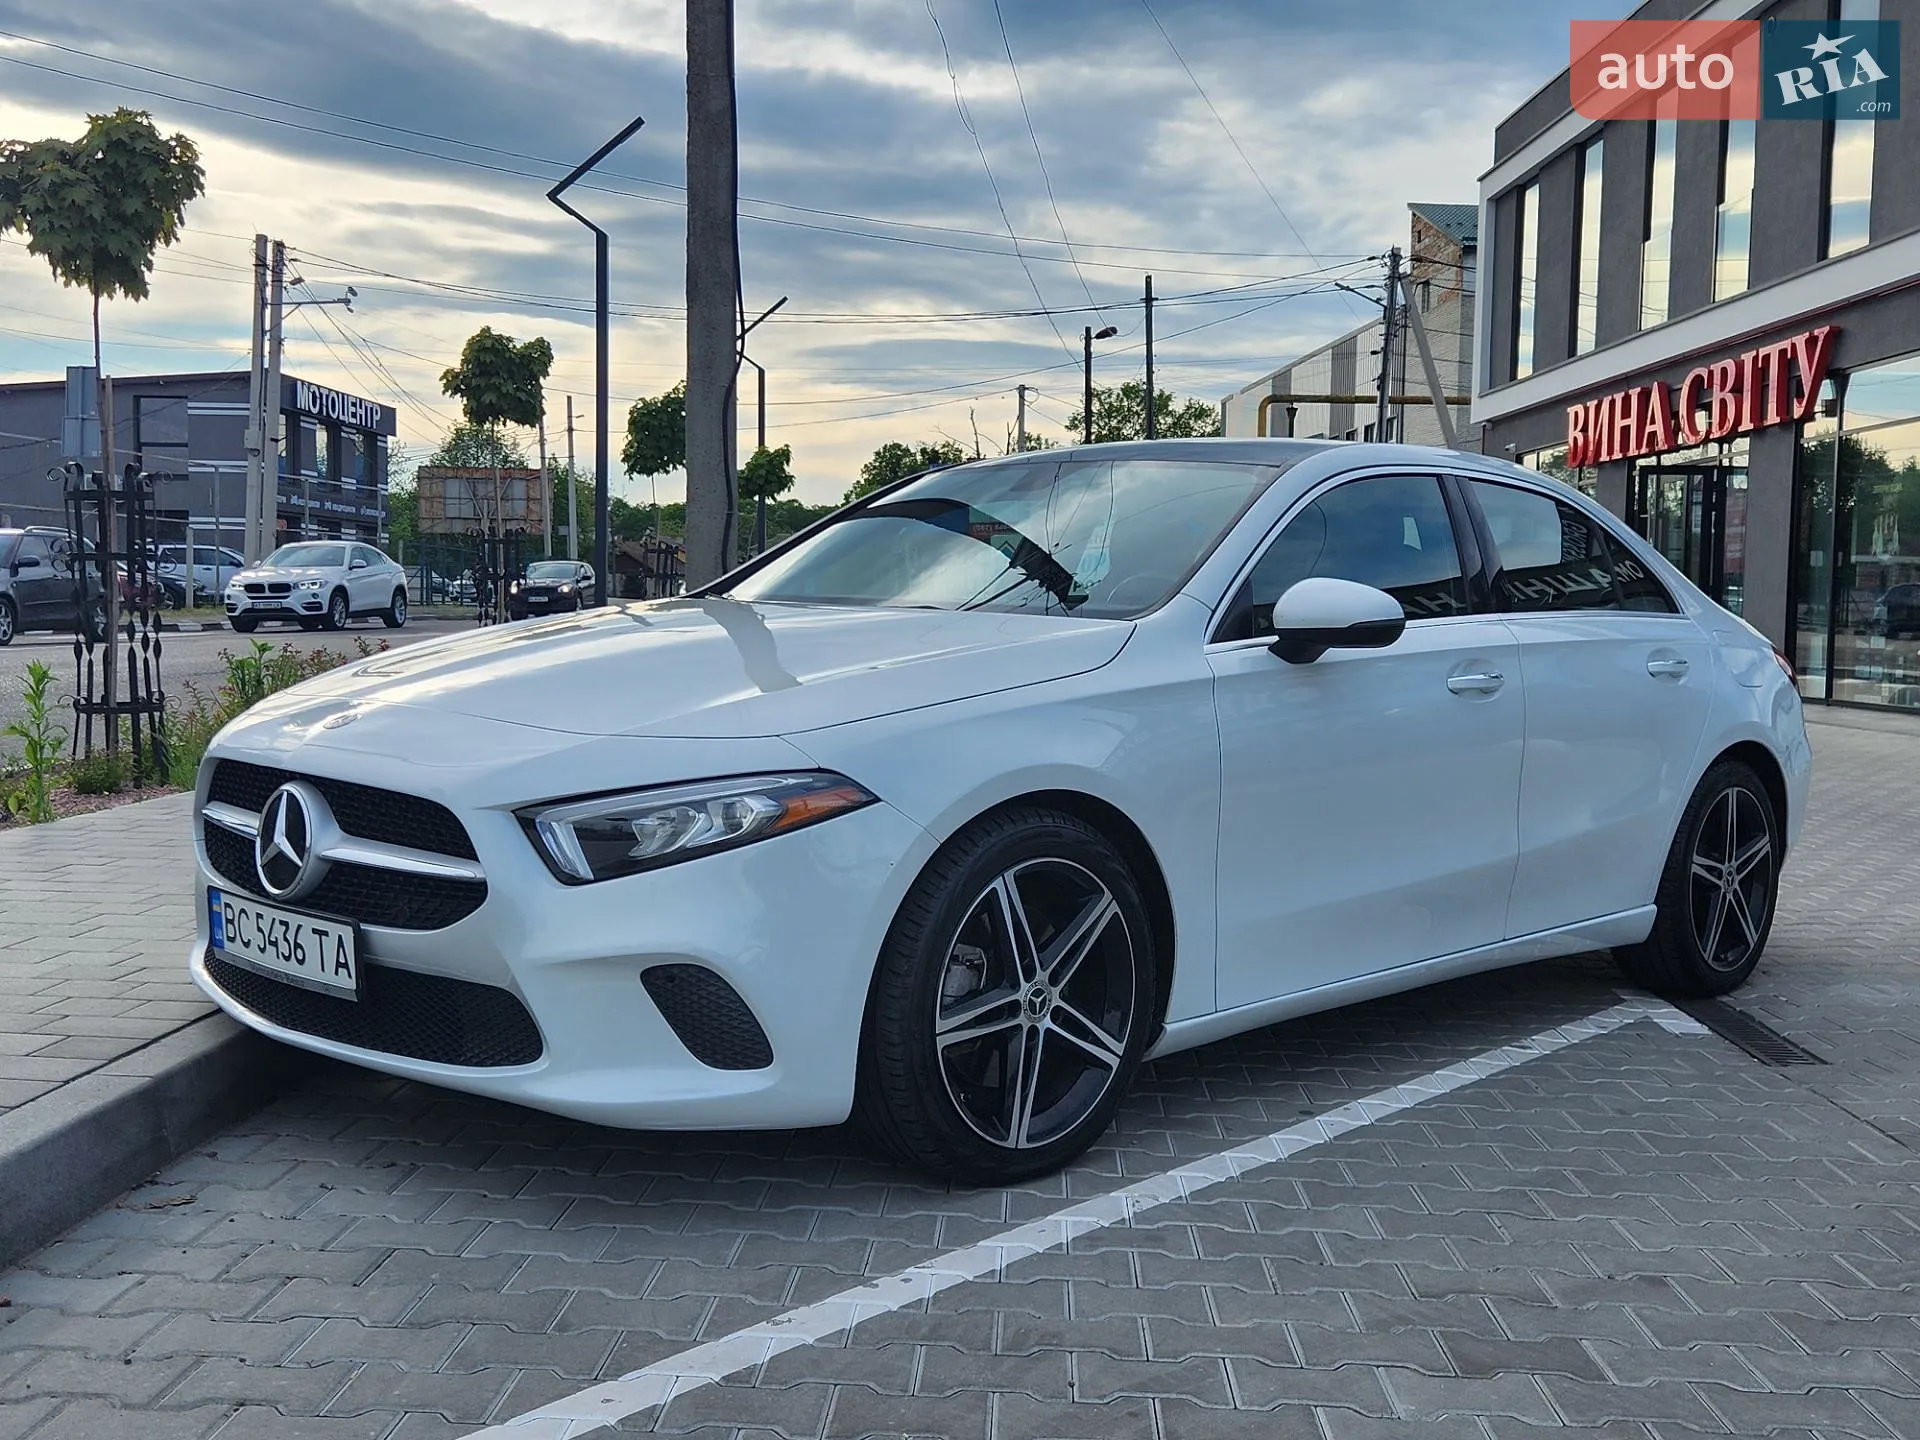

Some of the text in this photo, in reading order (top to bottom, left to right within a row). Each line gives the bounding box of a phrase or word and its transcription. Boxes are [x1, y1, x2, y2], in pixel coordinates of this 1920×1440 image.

[297, 381, 380, 429] МОТОЦЕНТР
[1568, 326, 1832, 468] ВИНА СВІТУ
[224, 901, 352, 979] BC 5436 TA
